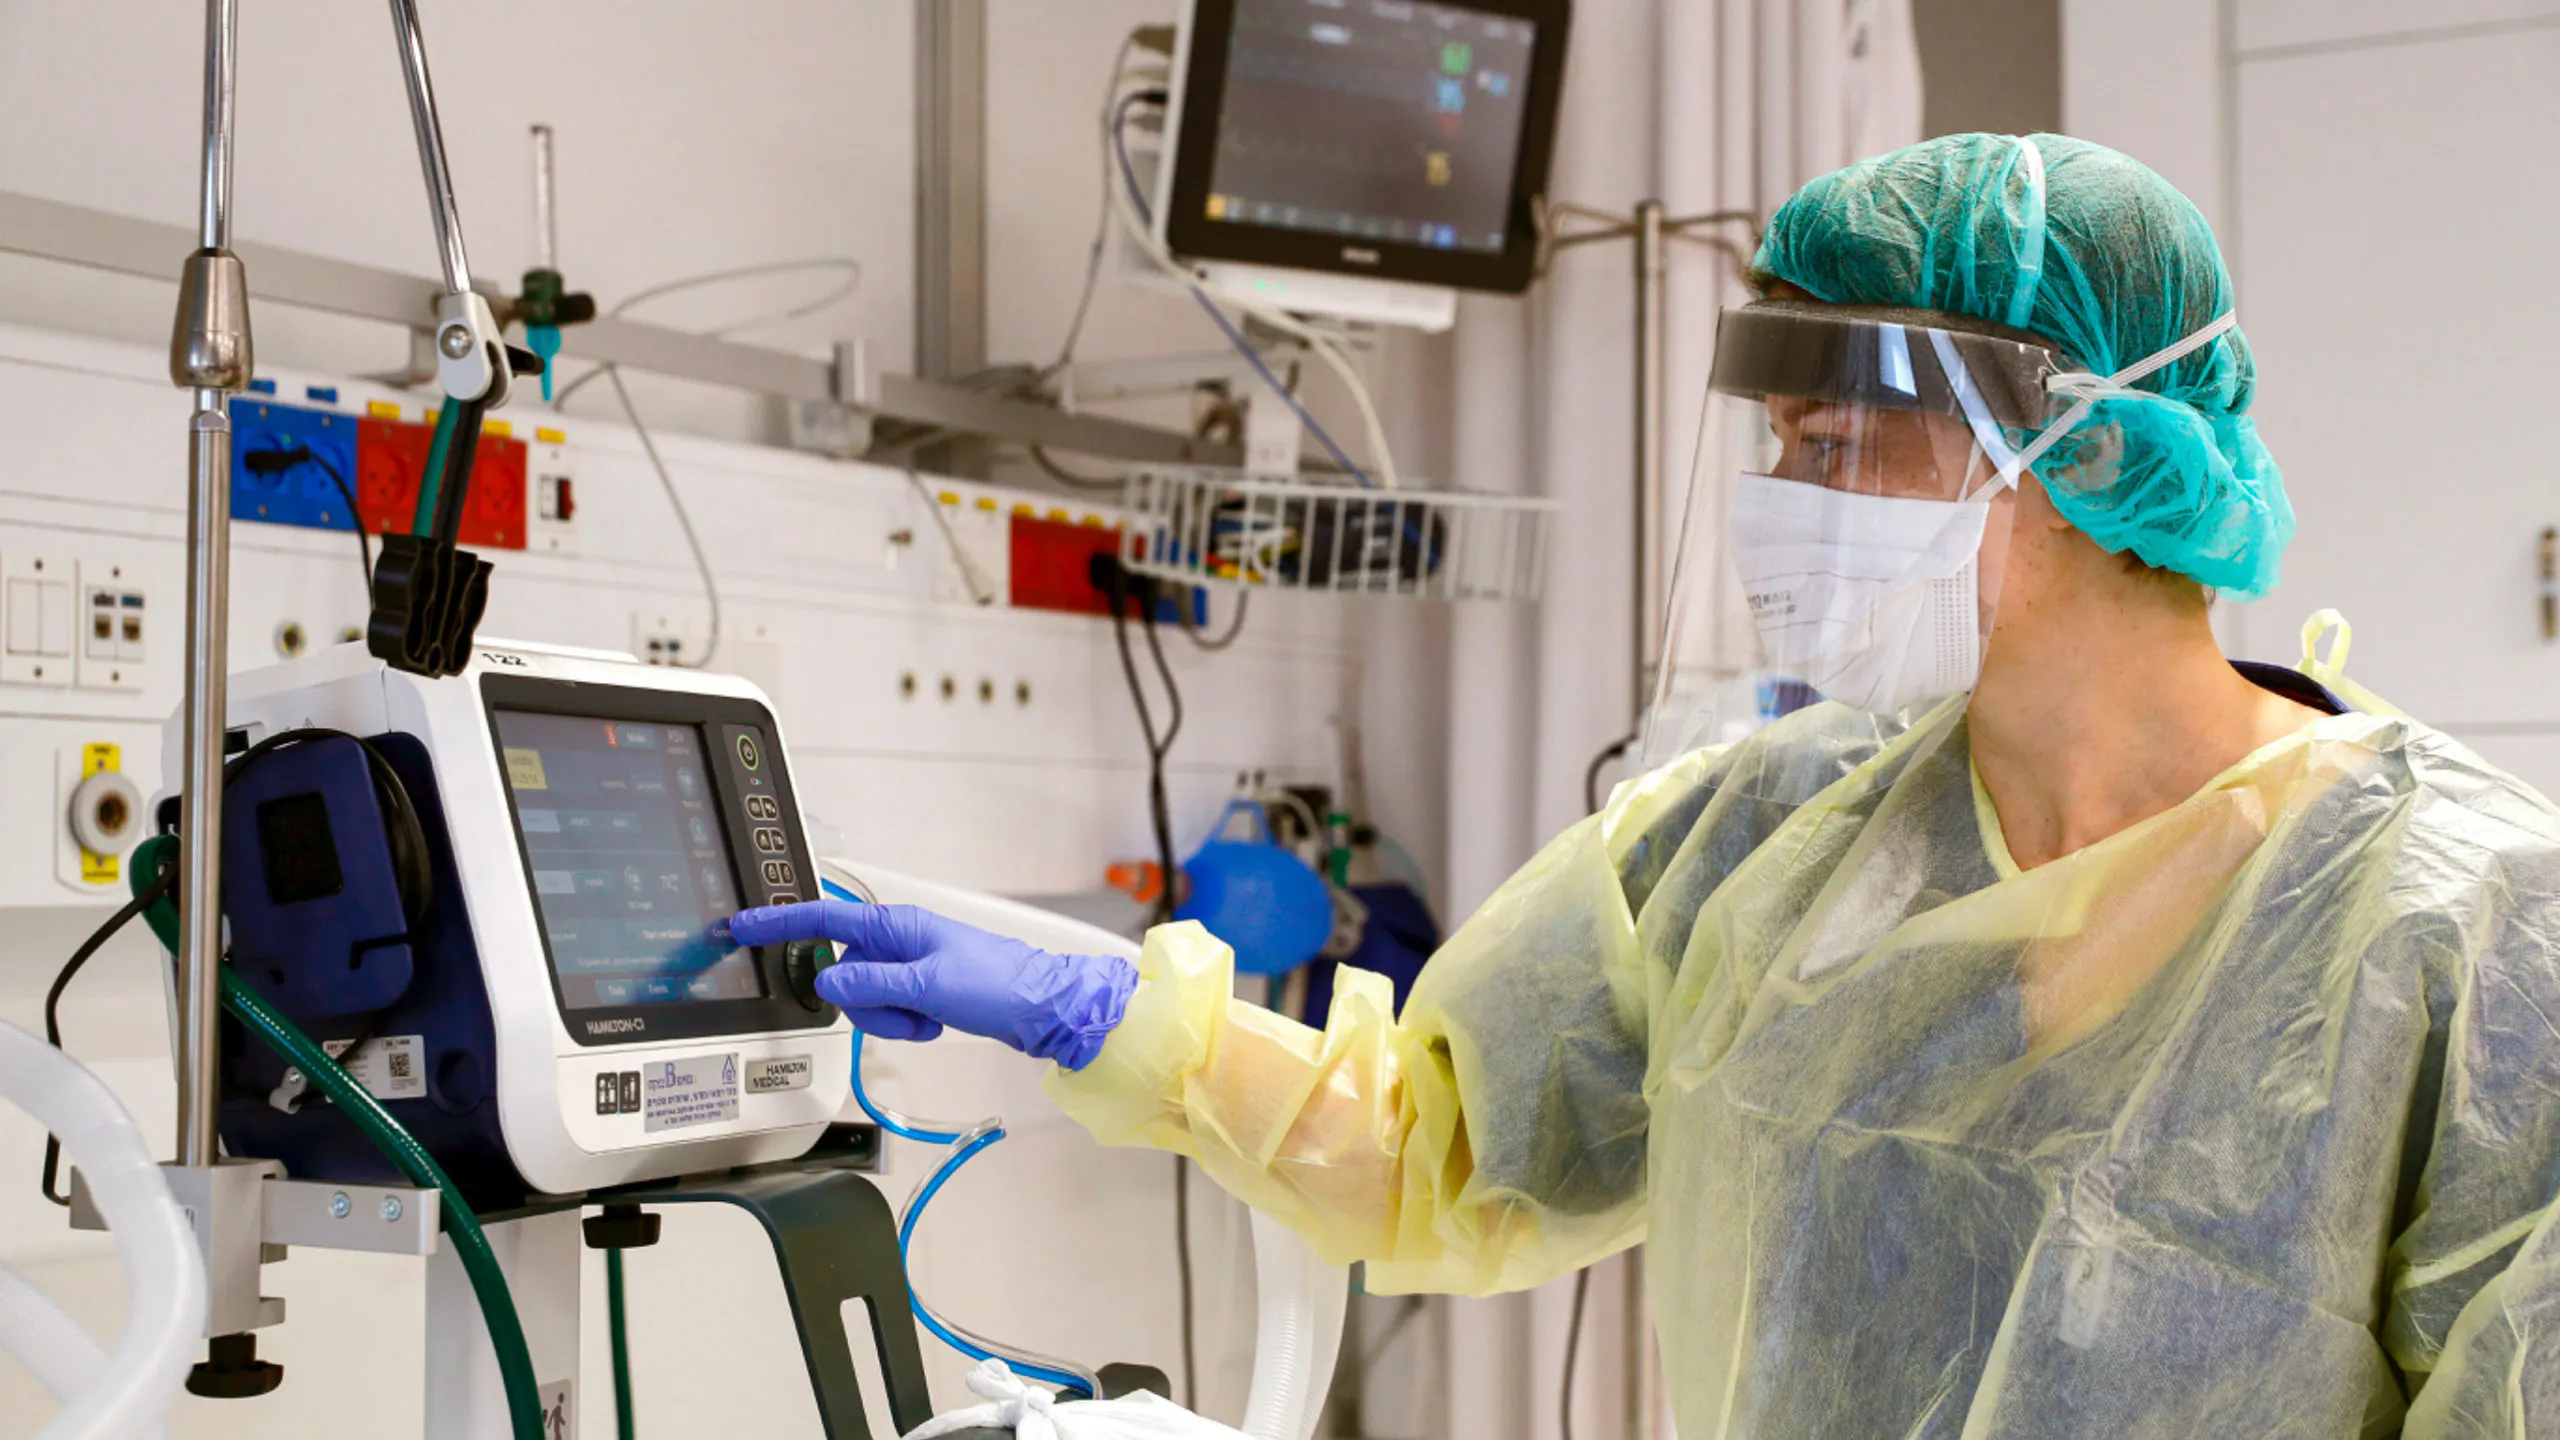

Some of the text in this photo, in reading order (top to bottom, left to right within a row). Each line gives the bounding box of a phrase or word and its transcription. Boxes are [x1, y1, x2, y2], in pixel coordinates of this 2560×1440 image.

[482, 653, 528, 667] 122
[766, 1061, 808, 1076] HAMILTON
[753, 1075, 790, 1089] MEDICAL
